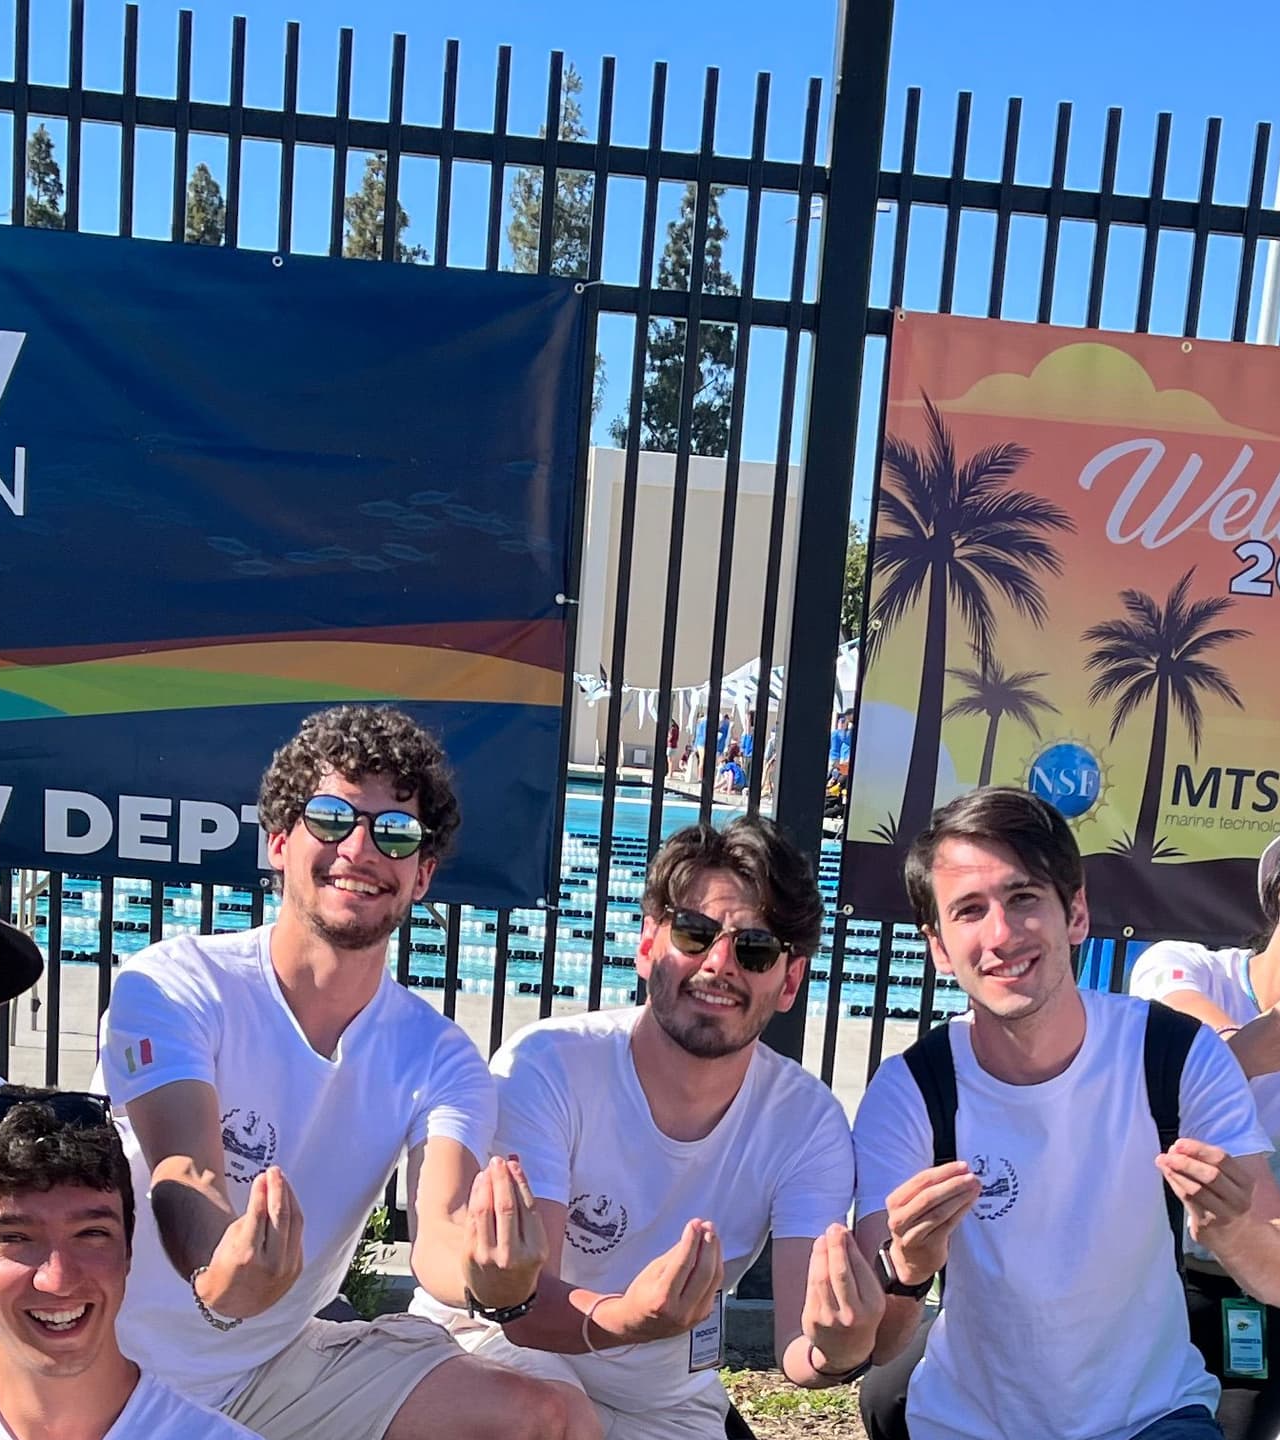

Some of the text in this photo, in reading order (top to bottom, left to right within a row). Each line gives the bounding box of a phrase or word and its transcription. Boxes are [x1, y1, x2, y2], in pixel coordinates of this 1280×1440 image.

[1030, 765, 1099, 798] NSF
[1170, 763, 1280, 813] MTS
[1164, 813, 1215, 829] marine
